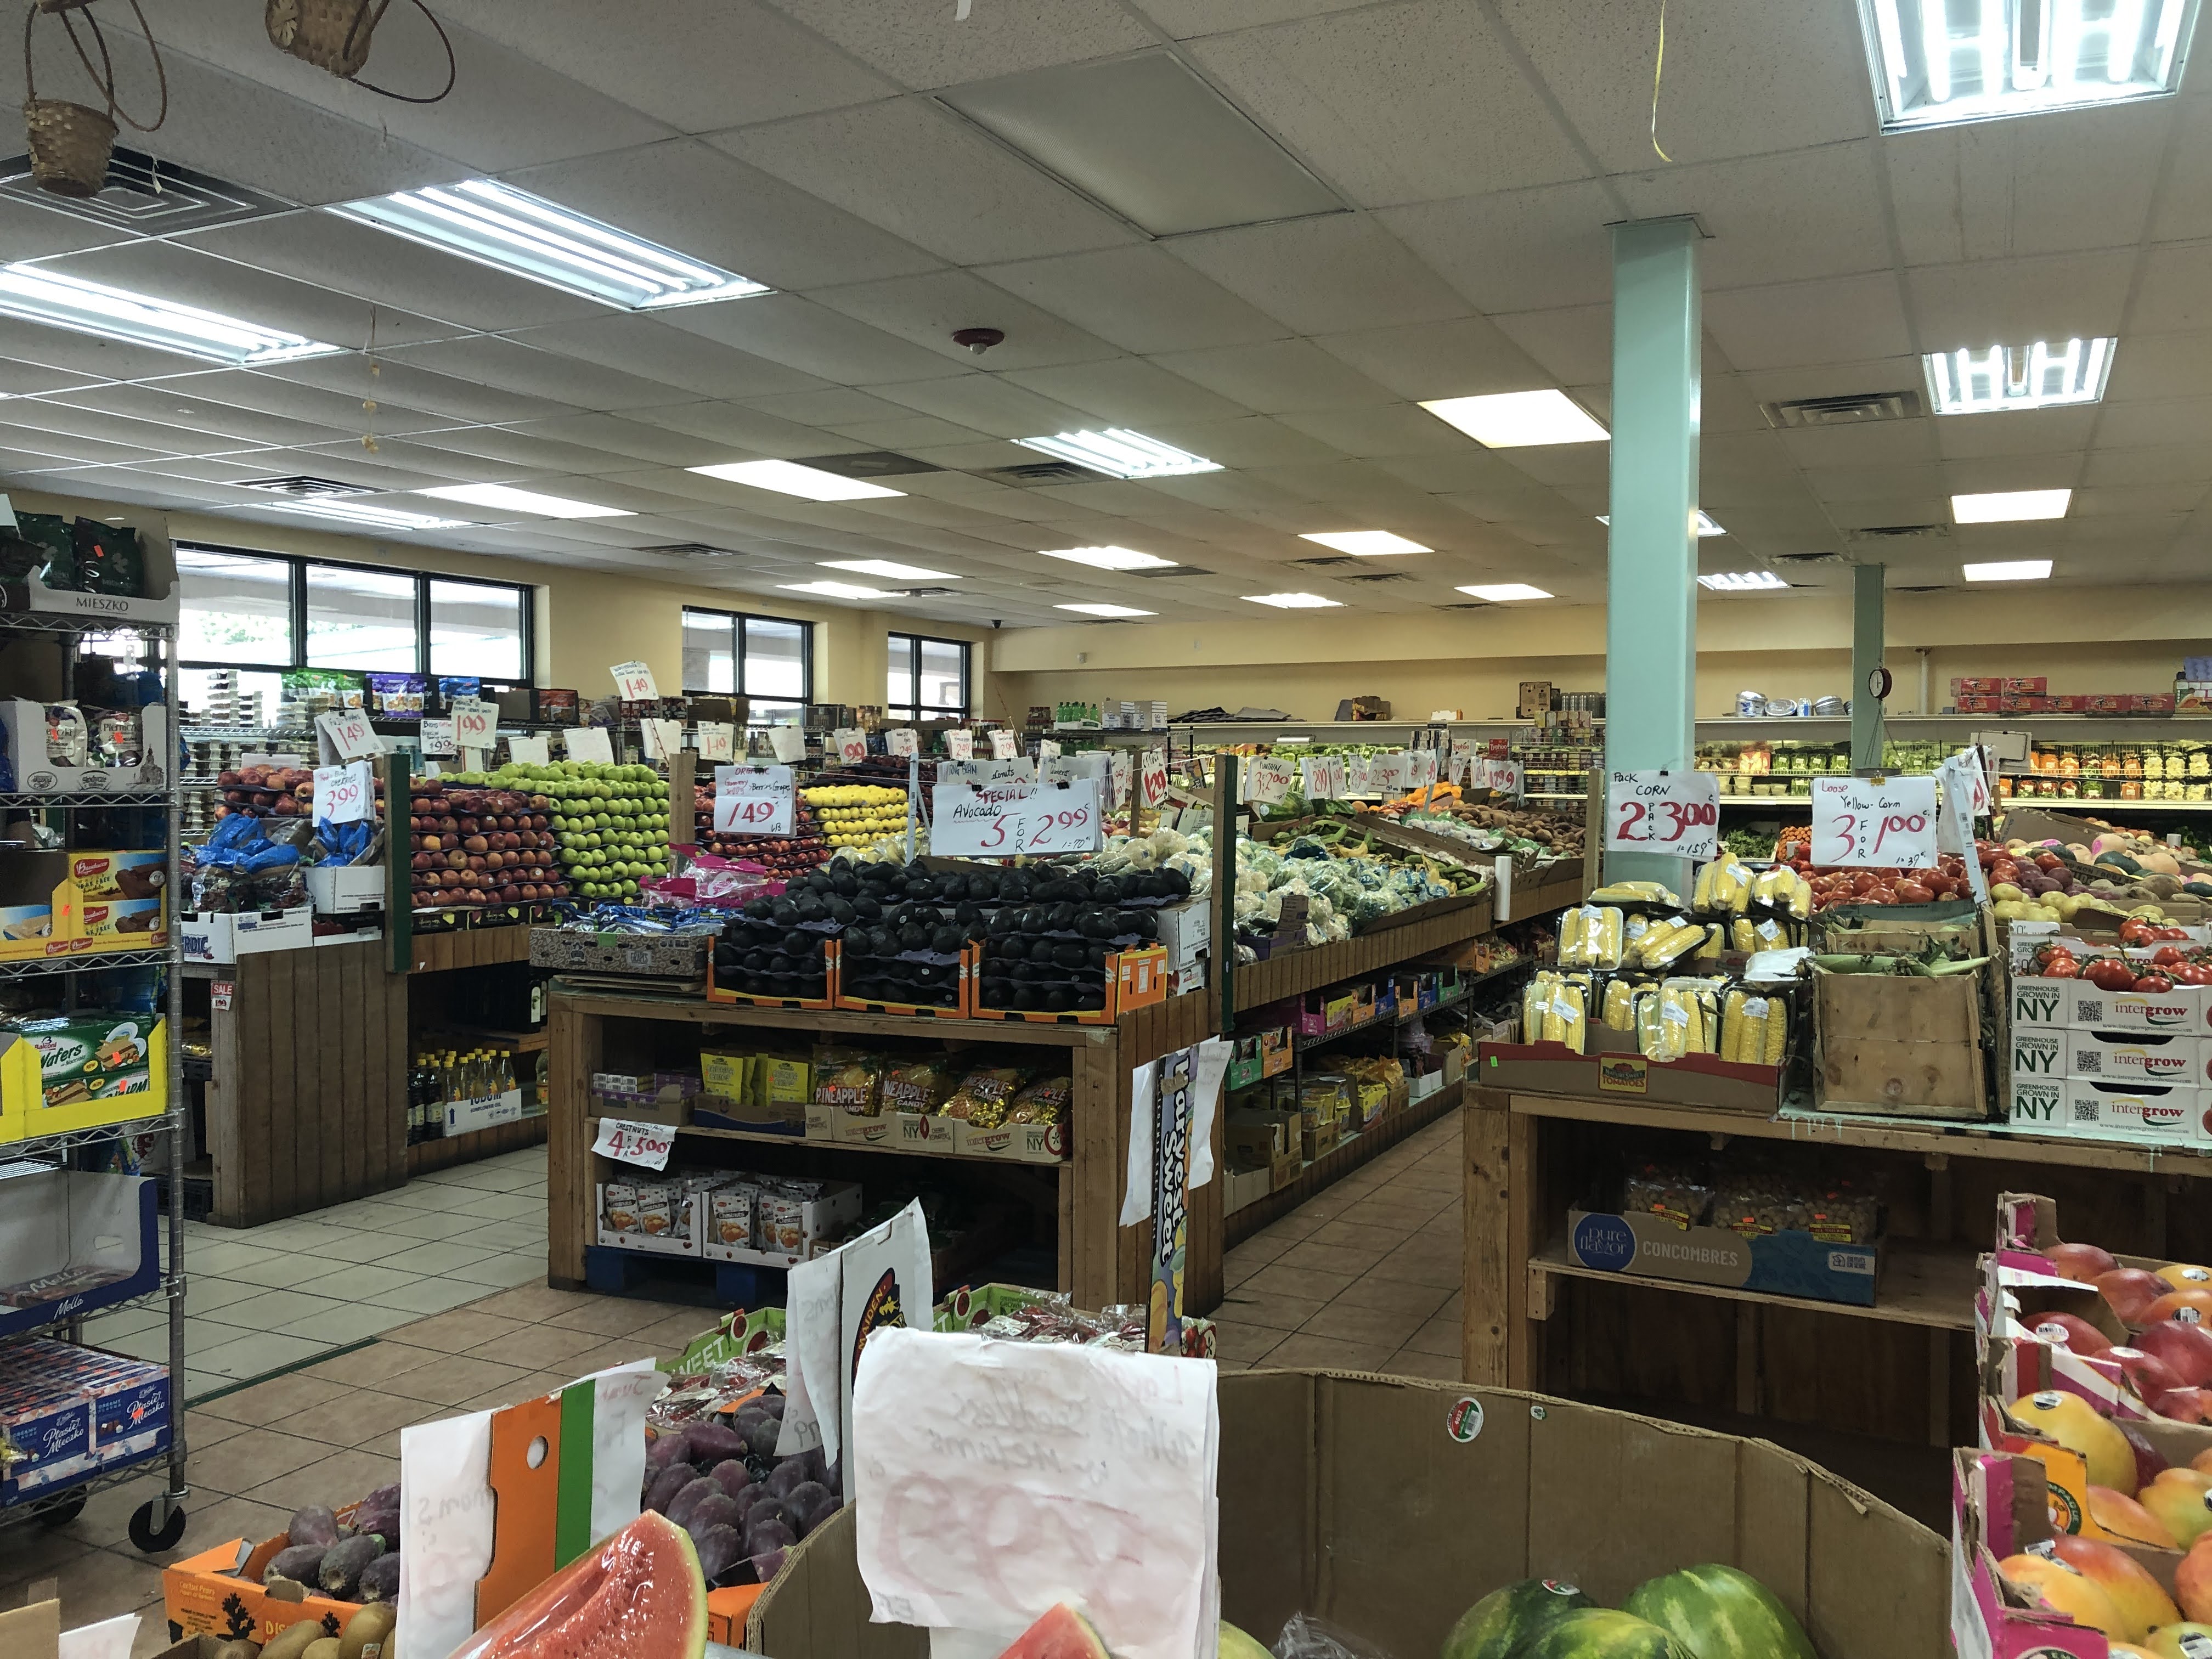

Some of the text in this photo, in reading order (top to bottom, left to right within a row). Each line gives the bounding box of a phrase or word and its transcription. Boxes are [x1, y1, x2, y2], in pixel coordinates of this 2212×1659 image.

[76, 597, 129, 612] MIESZKO
[625, 678, 648, 699] 149
[456, 714, 487, 741] 199
[337, 723, 365, 751] 149
[1452, 742, 1470, 752] Typhoo
[1490, 743, 1508, 752] Typhoo
[1265, 772, 1289, 791] 200
[1613, 771, 1639, 783] Pack
[1144, 769, 1167, 805] 129
[1635, 785, 1671, 796] CORN
[1821, 780, 1849, 793] Loose
[325, 783, 359, 819] 399
[1878, 797, 1901, 809] Corn
[727, 802, 775, 827] 149
[1616, 801, 1649, 842] 2
[1659, 801, 1717, 842] 300
[770, 822, 782, 833] LB
[980, 812, 1022, 847] 5
[1029, 808, 1088, 847] 299
[1831, 814, 1855, 863] 3
[1872, 814, 1927, 855] 100
[183, 935, 208, 955] RDIC
[213, 985, 233, 995] SALE
[2017, 991, 2050, 999] GROWN
[2017, 997, 2059, 1022] NY
[2115, 1001, 2188, 1017] intergrow
[2016, 1036, 2059, 1044] GREENHOUSE
[2016, 1042, 2049, 1050] GROWN
[2015, 1048, 2058, 1074] NY
[2114, 1052, 2187, 1068] intergrow
[1602, 1076, 1645, 1087] TOMATOES
[2016, 1083, 2059, 1092] GREENHOUSE
[816, 1087, 867, 1104] PINEAPPLE
[882, 1079, 931, 1102] INEAPPLE
[2016, 1089, 2059, 1098] GROWN IN
[896, 1099, 926, 1109] CANDY
[2016, 1096, 2059, 1121] NY
[2112, 1102, 2185, 1118] intergrow
[616, 1122, 649, 1136] CHESTNUTS
[845, 1124, 887, 1137] intergrow
[903, 1126, 919, 1138] NY
[607, 1130, 625, 1157] 4
[629, 1136, 668, 1156] 500
[966, 1132, 1011, 1146] intergrow
[1026, 1138, 1044, 1151] NY
[1172, 1057, 1190, 1228] Harvest
[1161, 1130, 1178, 1263] Sweet
[1589, 1227, 1627, 1242] pure
[1643, 1240, 1738, 1266] CONCOMBRES
[53, 1294, 84, 1321] Mella
[858, 1288, 883, 1350] MAIDEN
